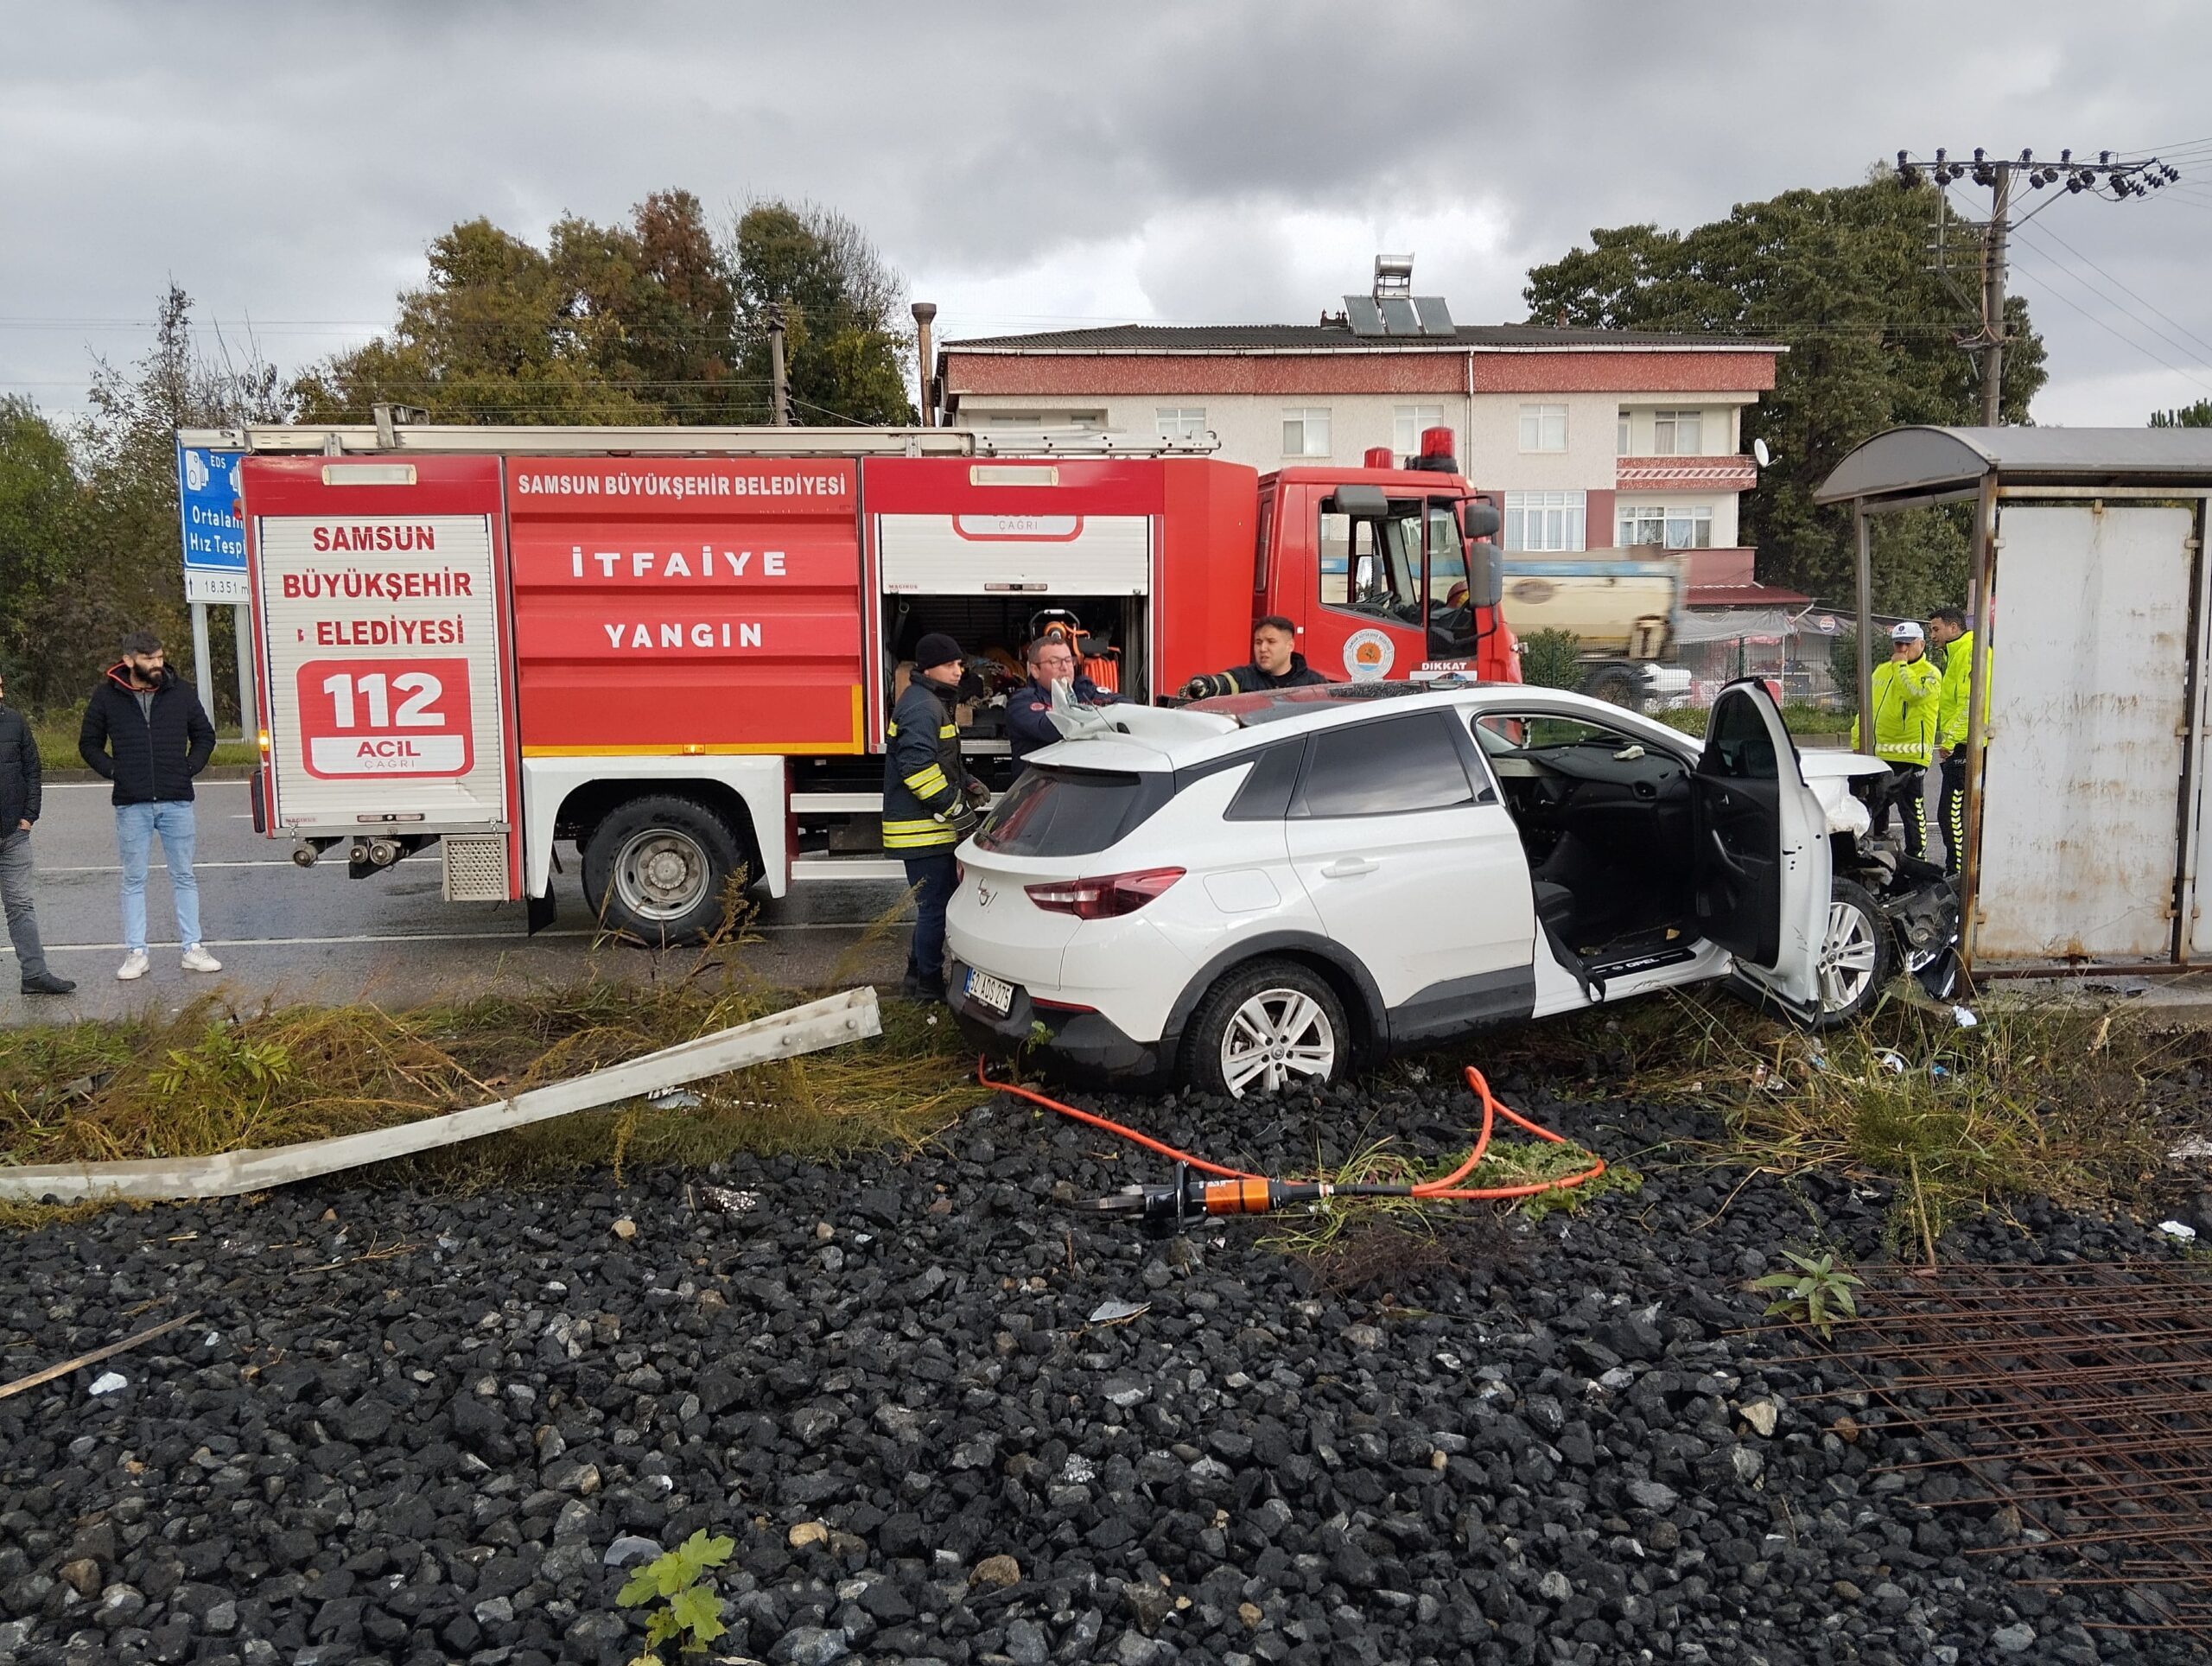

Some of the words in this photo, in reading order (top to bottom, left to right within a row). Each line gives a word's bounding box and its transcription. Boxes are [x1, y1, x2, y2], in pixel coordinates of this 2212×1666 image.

[211, 455, 226, 469] EDS
[518, 474, 600, 495] SAMSUN
[605, 472, 731, 499] BÜYÜKŞEHİR
[734, 472, 846, 496] BELEDİYESİ
[190, 532, 212, 552] Hız
[313, 526, 435, 551] SAMSUN
[572, 545, 787, 577] İTFAİYE
[205, 580, 238, 595] 18.351
[283, 567, 473, 601] BÜYÜKŞEHİR
[297, 614, 464, 646] ELEDİYESİ
[604, 623, 762, 648] YANGIN
[1421, 662, 1468, 671] DIKKAT
[323, 671, 446, 728] 112
[357, 741, 421, 758] ACİL
[1625, 957, 1660, 969] OPEL
[970, 970, 981, 993] 52
[981, 976, 995, 1002] ADS
[995, 983, 1010, 1009] 275
